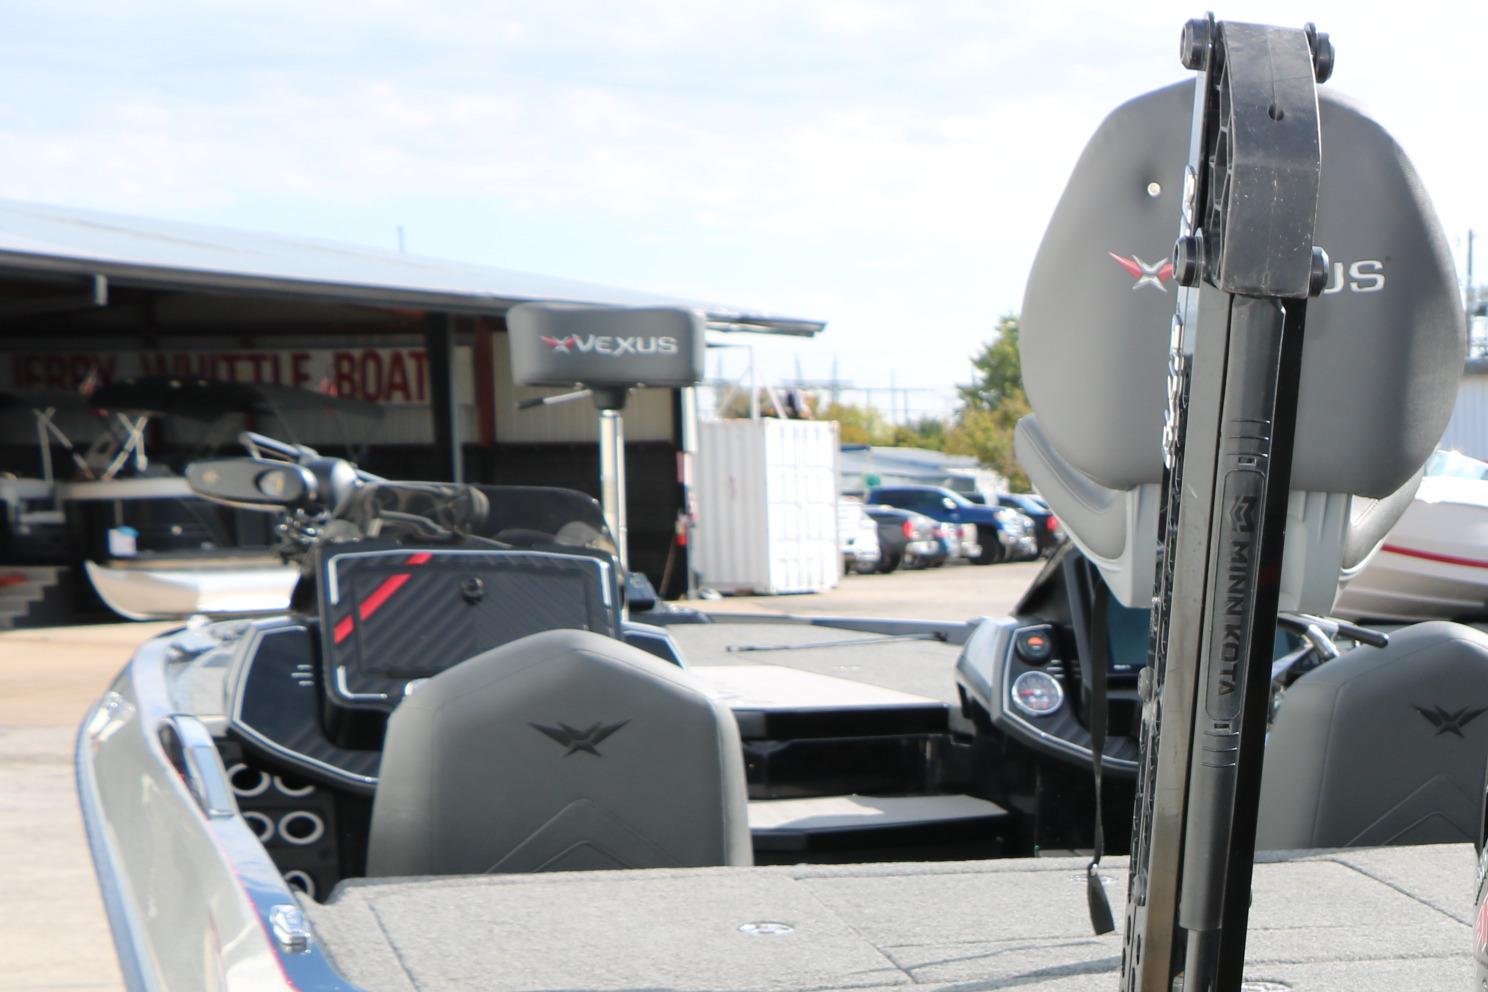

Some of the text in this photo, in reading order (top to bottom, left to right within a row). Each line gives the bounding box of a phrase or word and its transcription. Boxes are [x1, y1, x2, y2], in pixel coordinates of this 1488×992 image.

[574, 333, 679, 355] VEXUS
[335, 350, 427, 400] BOAT
[1217, 541, 1250, 697] MINN KOTA
